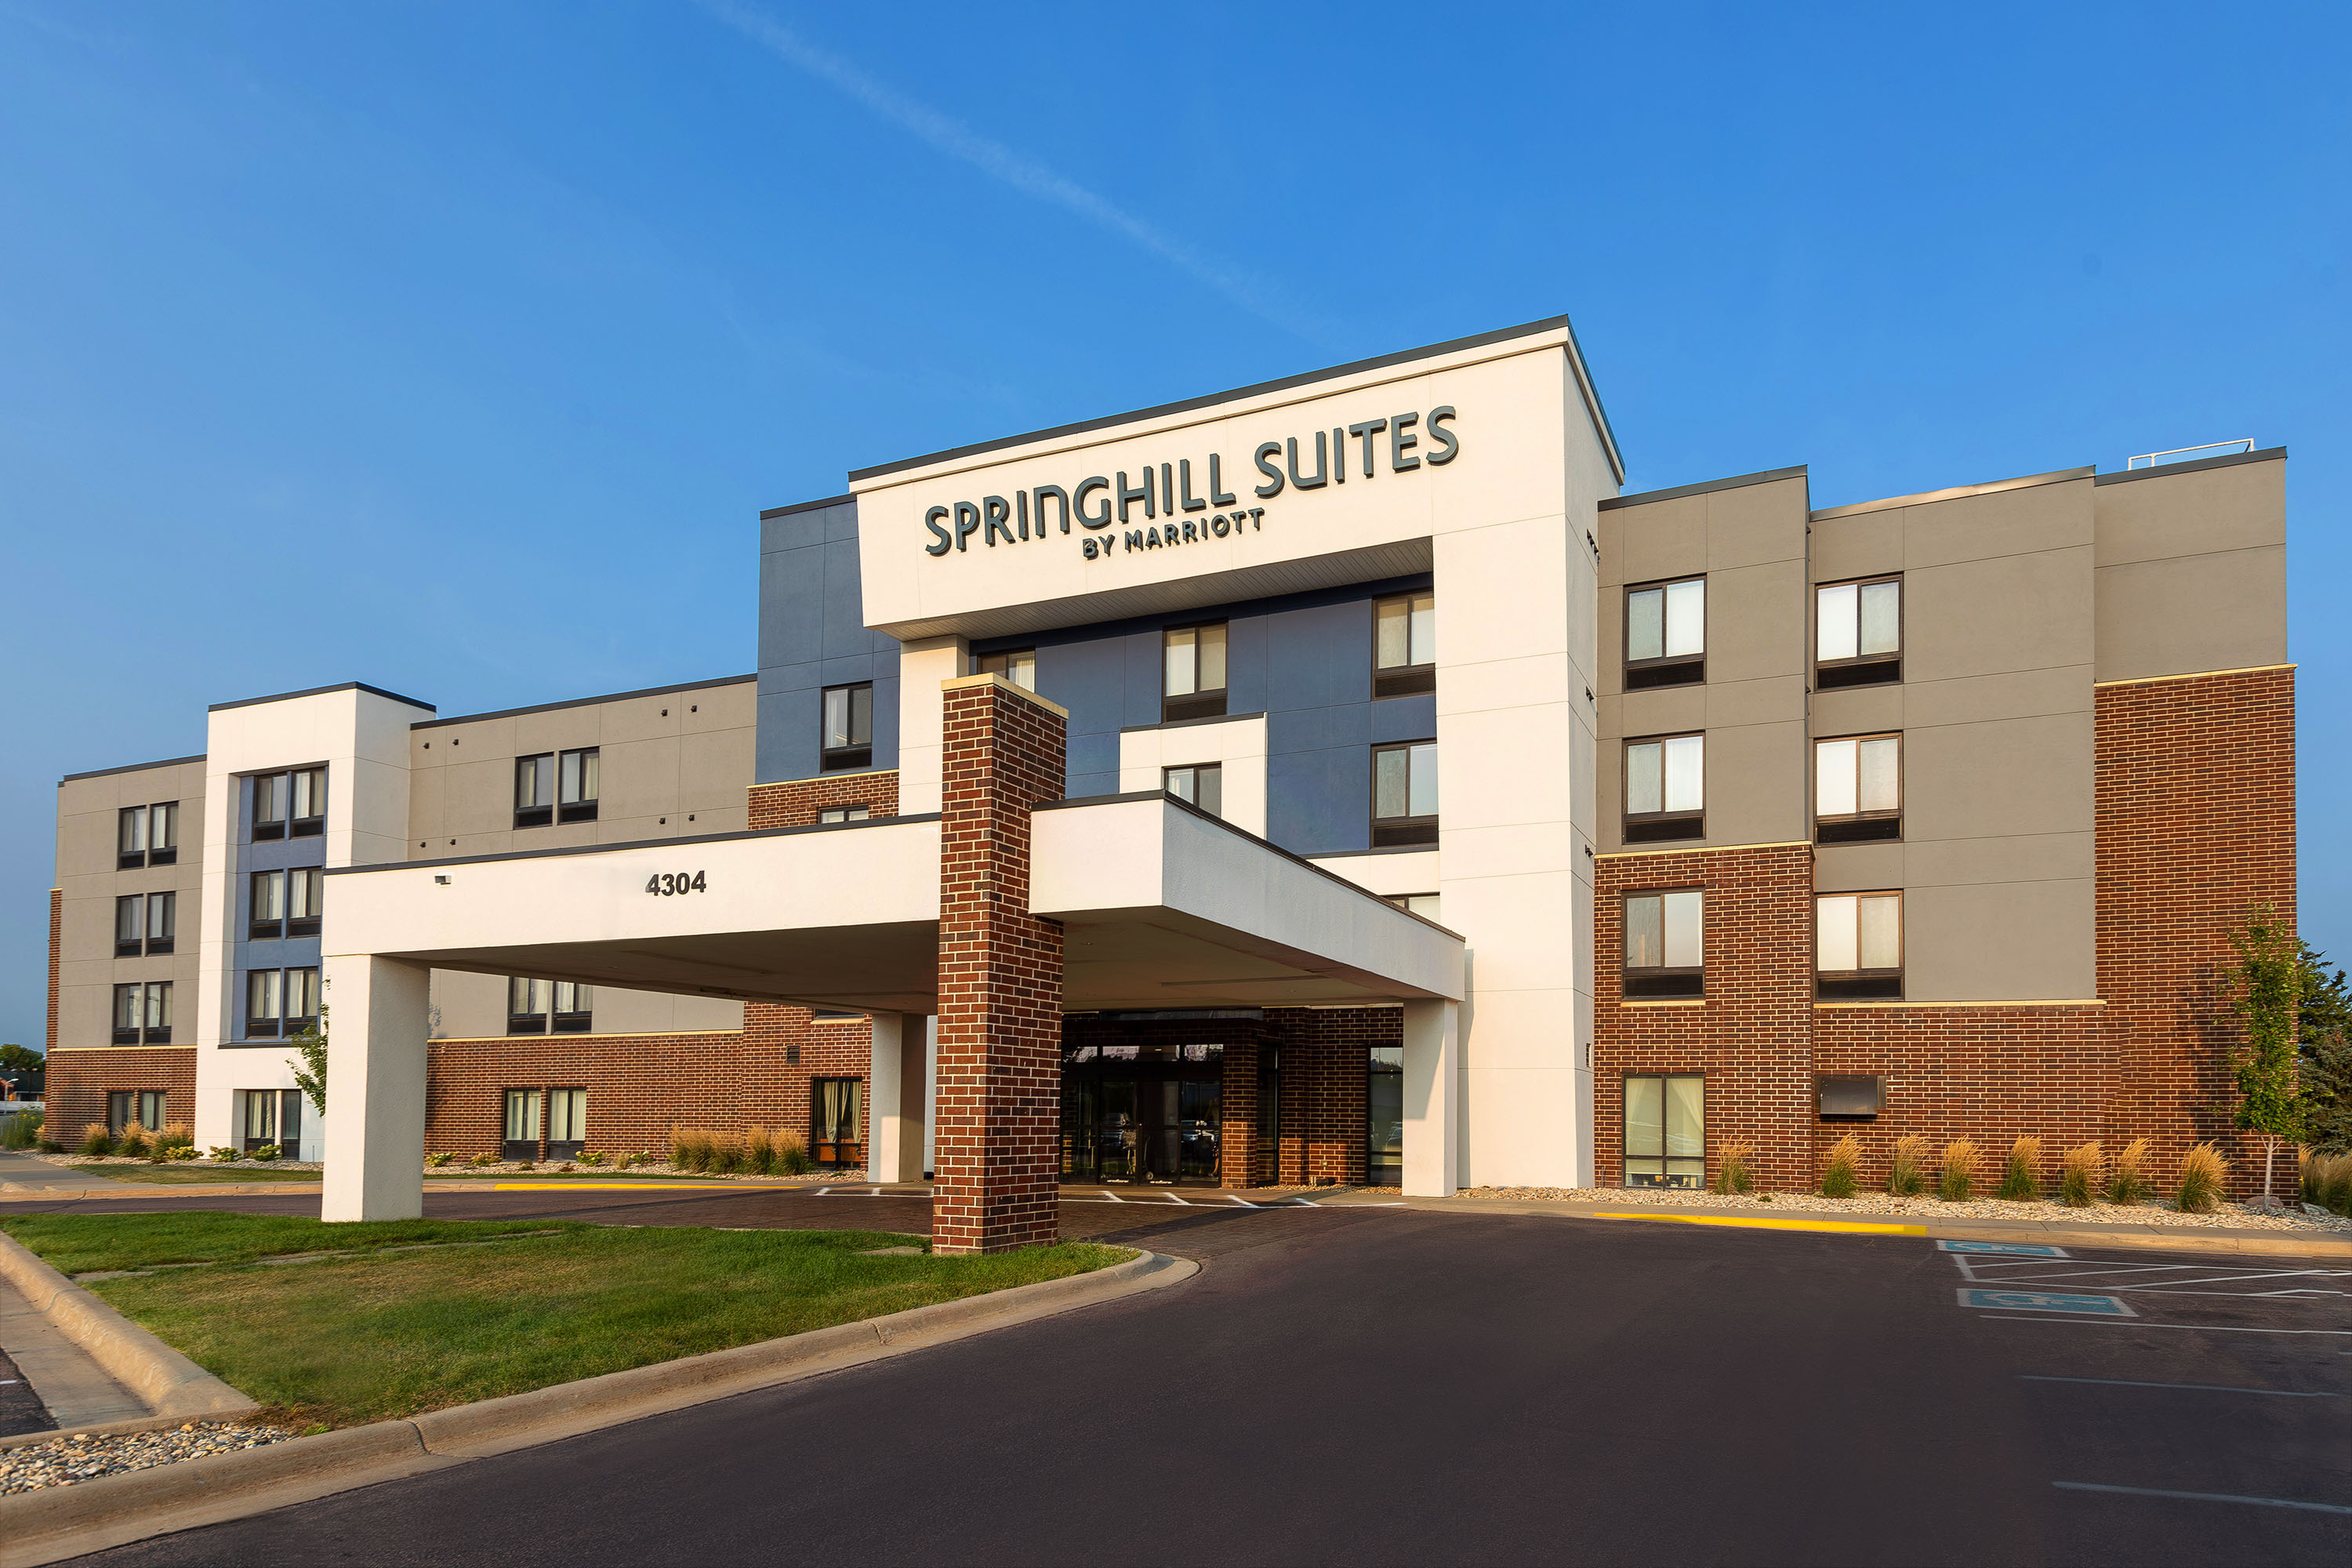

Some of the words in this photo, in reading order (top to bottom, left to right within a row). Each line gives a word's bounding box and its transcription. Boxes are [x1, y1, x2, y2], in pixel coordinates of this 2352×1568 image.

[925, 453, 1236, 557] SPRINGHILL
[1254, 405, 1459, 499] SUITES
[1083, 534, 1116, 561] BY
[1125, 507, 1265, 554] MARRIOTT
[645, 870, 706, 896] 4304
